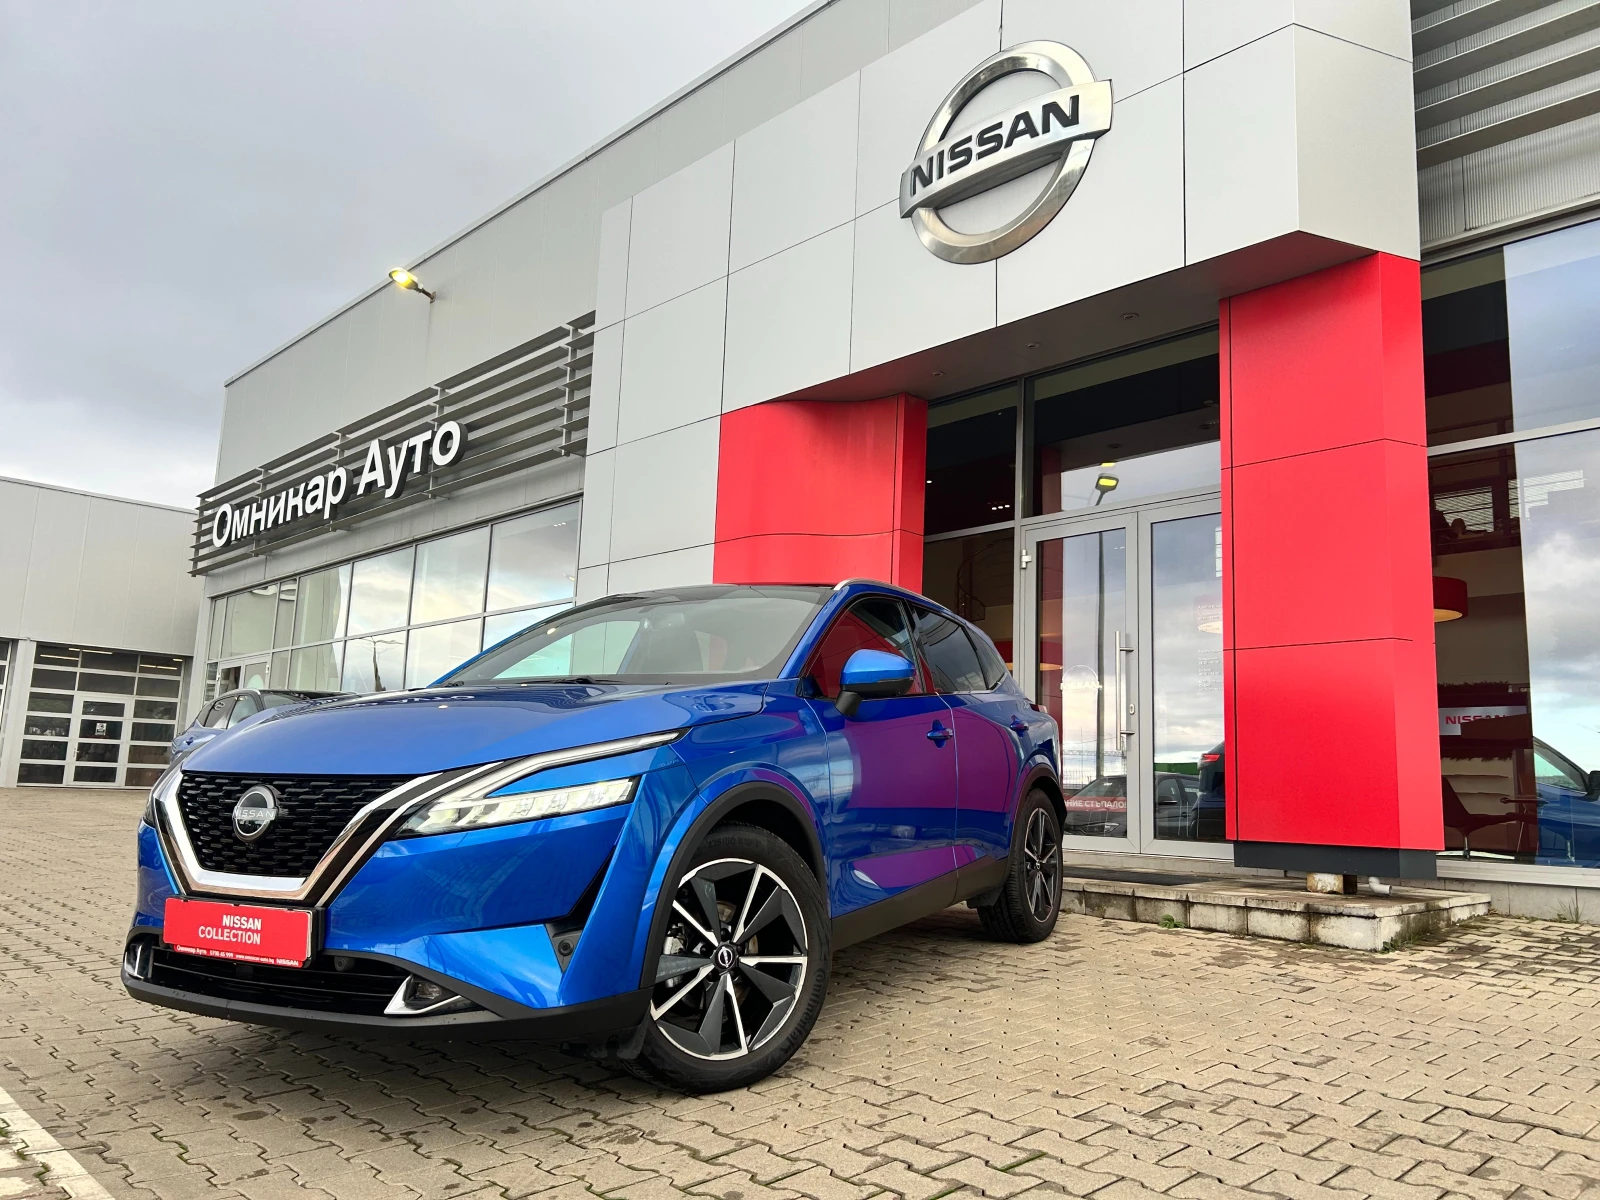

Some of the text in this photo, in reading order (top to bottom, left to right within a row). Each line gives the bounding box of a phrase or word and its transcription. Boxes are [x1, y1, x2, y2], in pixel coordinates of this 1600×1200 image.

[910, 94, 1080, 197] NISSAN
[212, 420, 462, 548] Омникар Ауто
[234, 808, 275, 819] NISSAN
[222, 915, 261, 930] NISSAN
[198, 926, 261, 945] COLLECTION
[276, 958, 298, 966] NISSAN
[786, 967, 826, 1048] Continental
